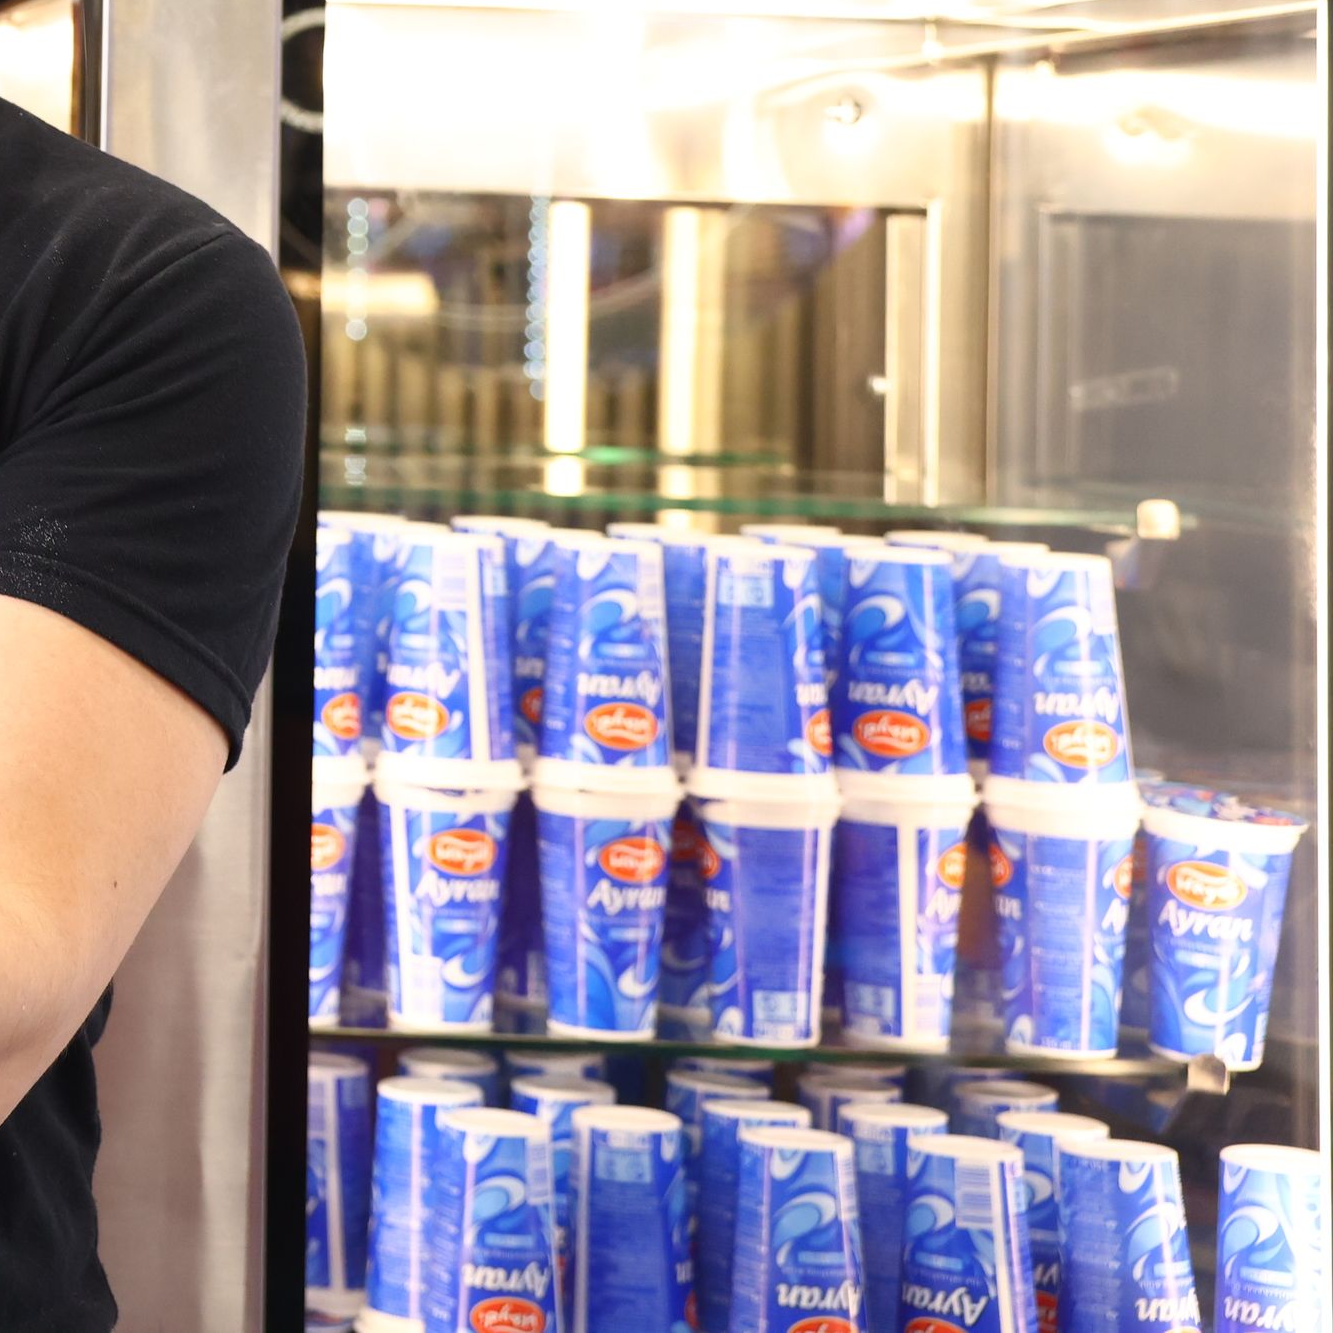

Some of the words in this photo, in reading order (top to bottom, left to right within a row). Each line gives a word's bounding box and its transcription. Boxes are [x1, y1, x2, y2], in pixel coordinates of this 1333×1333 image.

[387, 662, 460, 698] Ayran
[577, 670, 661, 703] Ayran
[848, 679, 939, 713] Ayran
[1034, 690, 1119, 722] Ayran
[587, 878, 666, 916] Ayran
[1158, 901, 1254, 942] Ayran
[460, 1263, 551, 1299] Ayran
[776, 1280, 863, 1317] Ayran
[902, 1283, 989, 1326] Ayran
